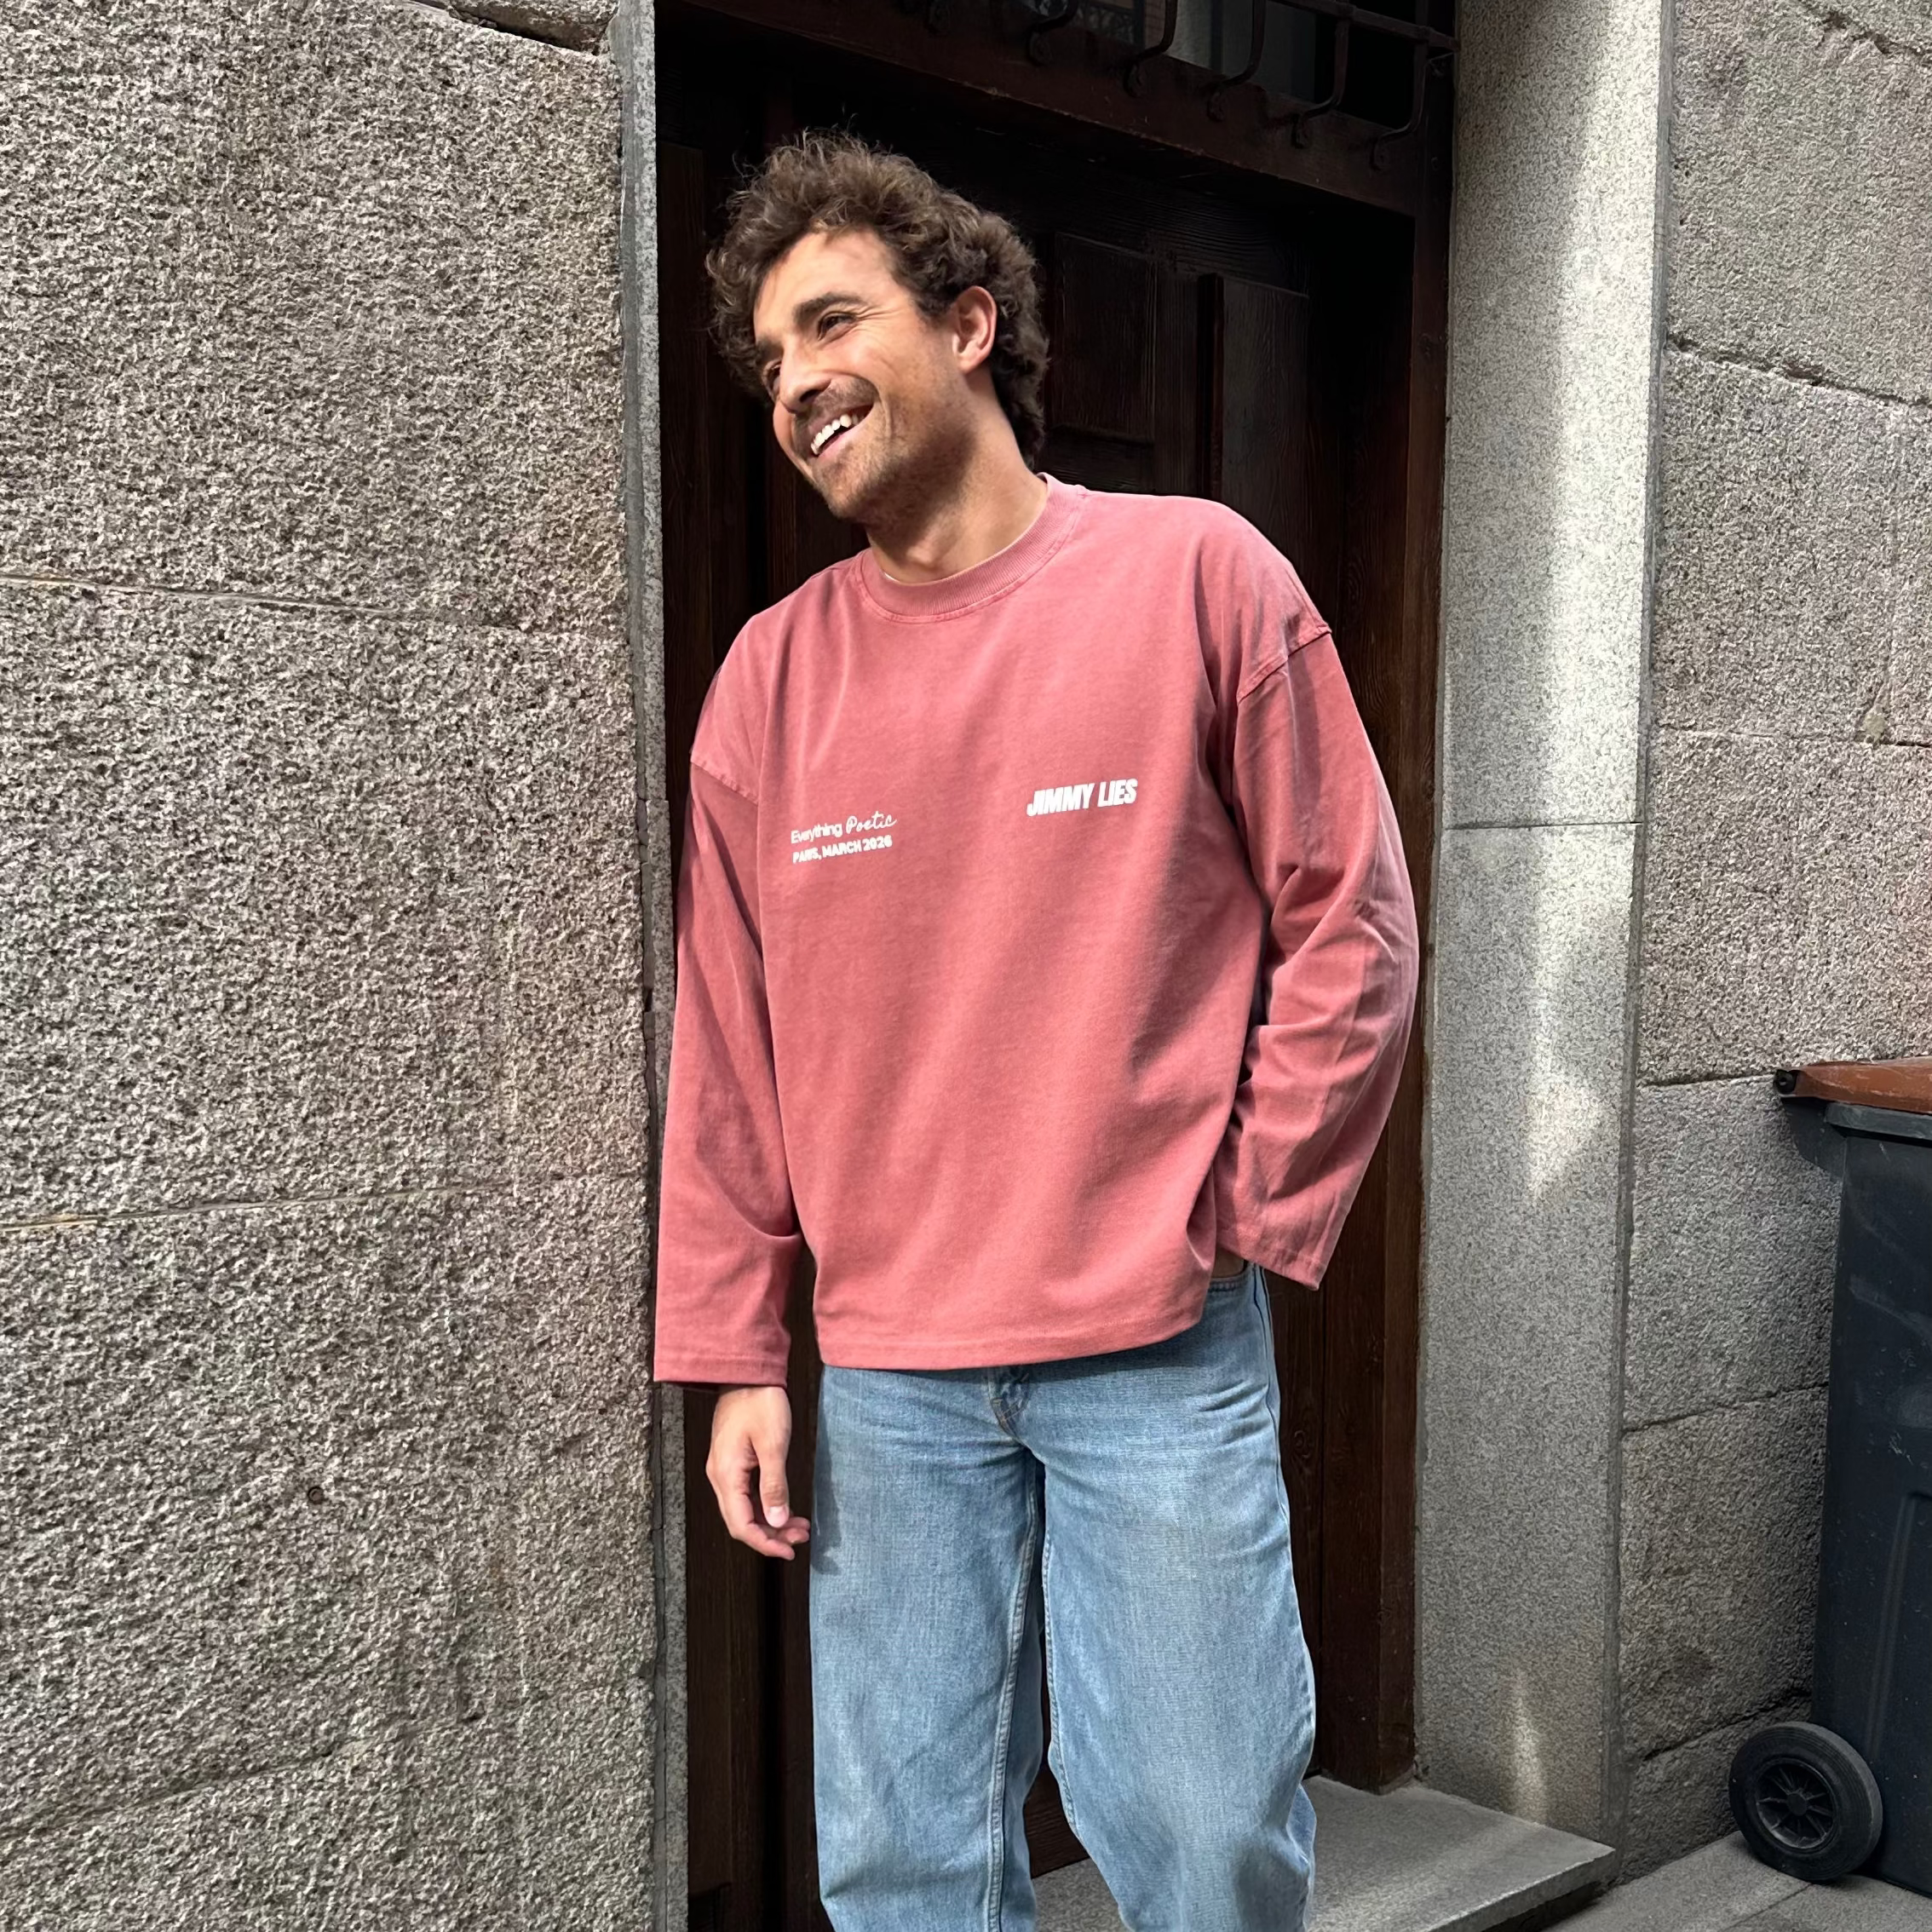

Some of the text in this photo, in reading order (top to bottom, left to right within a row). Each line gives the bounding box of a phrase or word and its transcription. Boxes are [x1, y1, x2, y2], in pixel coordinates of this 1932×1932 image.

[1026, 778, 1138, 816] JIMMY LIES
[791, 810, 897, 843] Everything Poetic
[792, 834, 893, 864] PARIS, MARCH 2026
